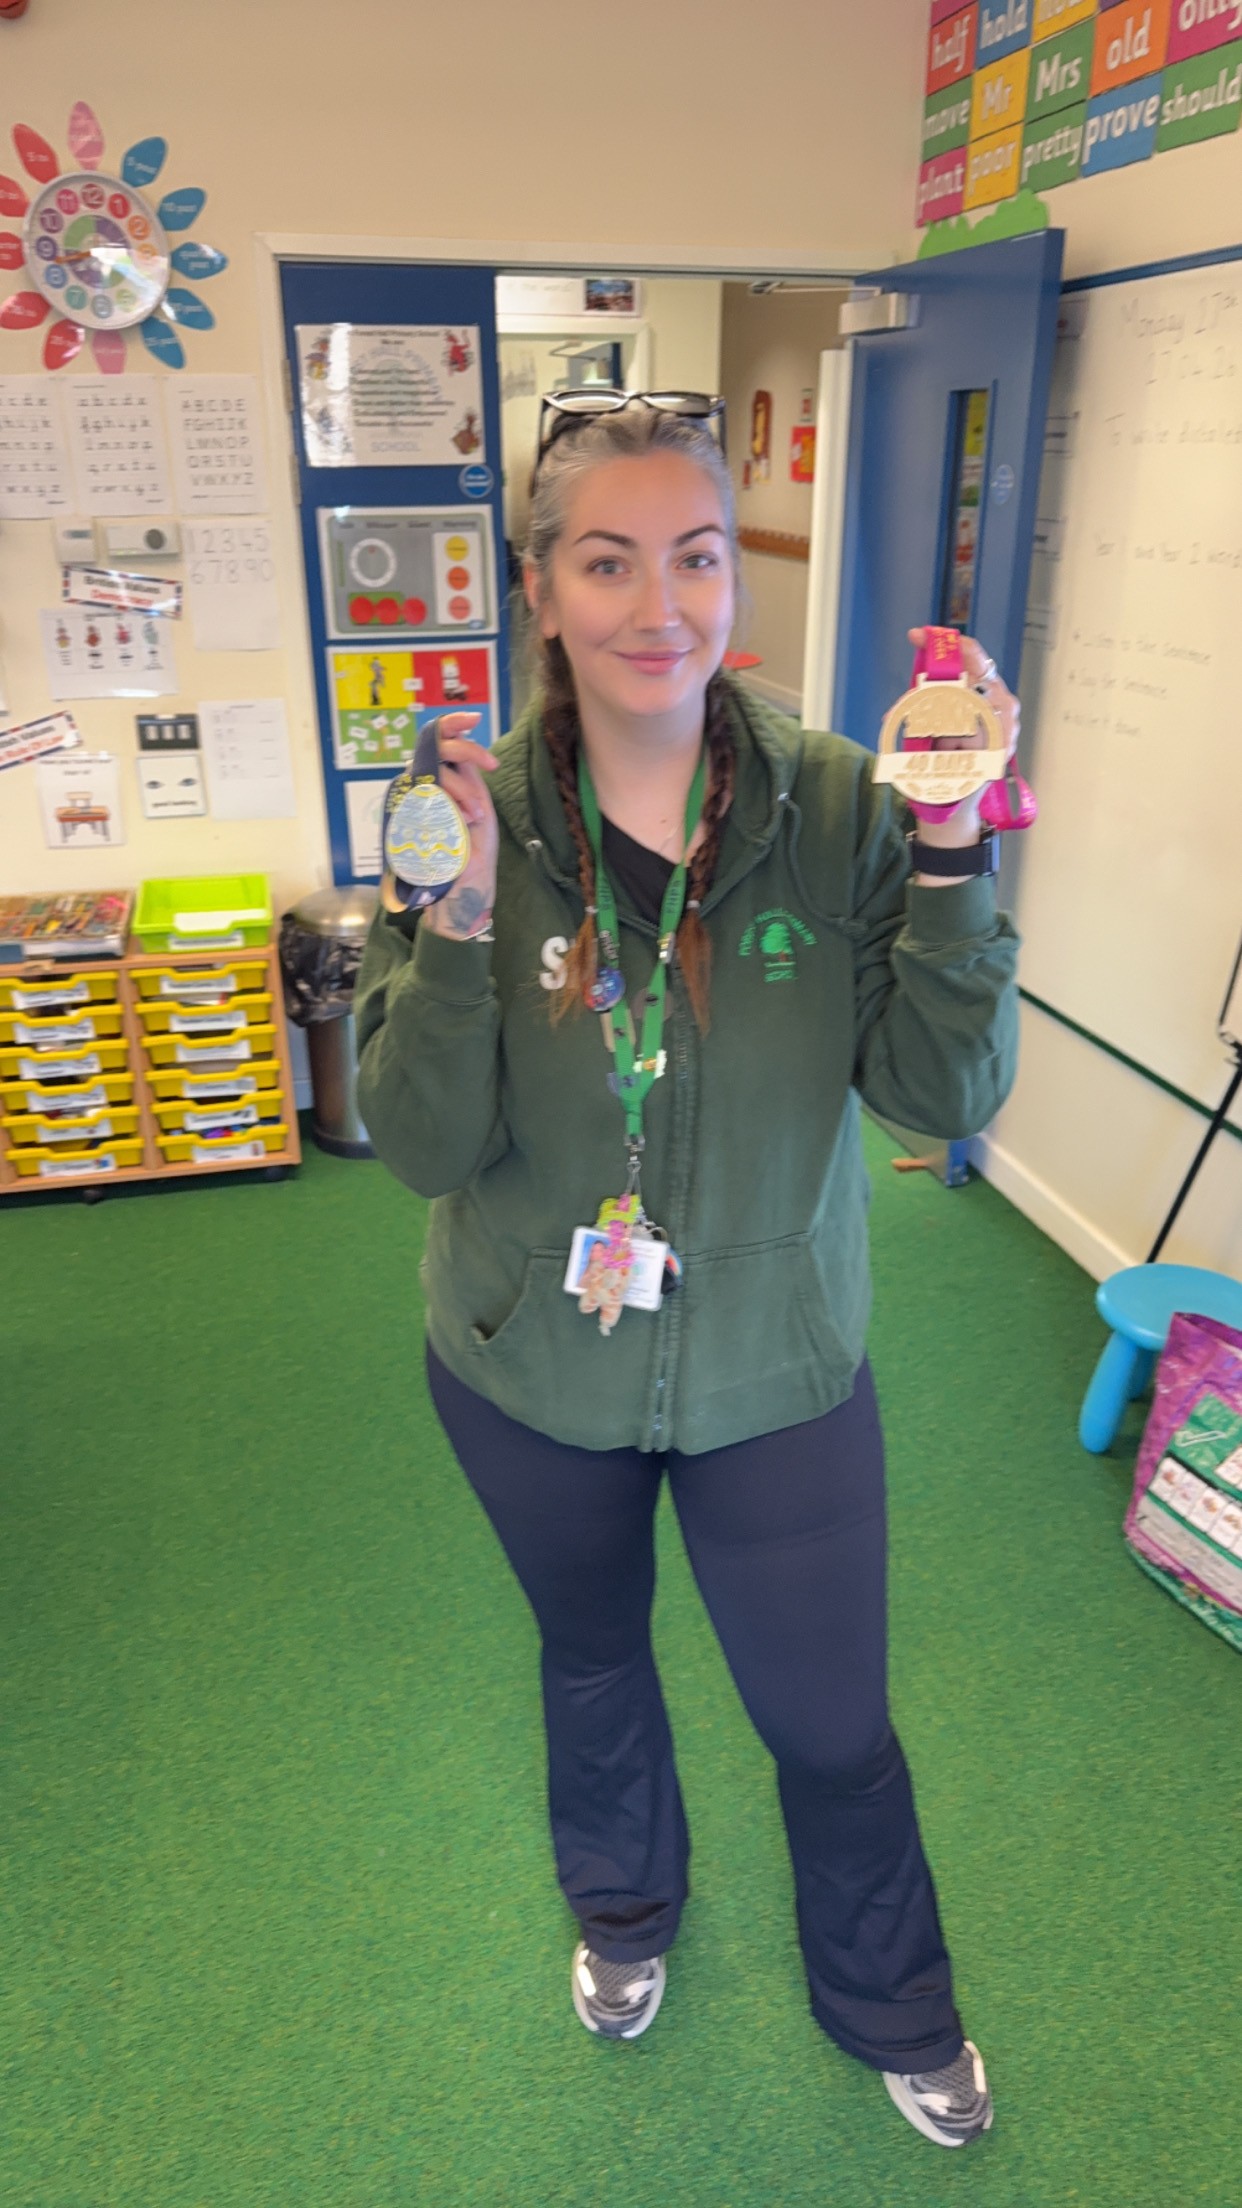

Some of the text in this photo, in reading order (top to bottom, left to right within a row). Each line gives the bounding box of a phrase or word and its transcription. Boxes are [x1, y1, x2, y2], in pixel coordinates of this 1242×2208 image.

[931, 14, 971, 73] half
[979, 0, 1028, 49] hold
[1106, 8, 1152, 71] old
[981, 75, 1012, 121] Mr
[1033, 51, 1082, 102] Mrs
[1160, 64, 1242, 126] should
[924, 97, 971, 139] move
[1081, 93, 1160, 165] prove
[968, 141, 1016, 196] poor
[1021, 124, 1083, 183] pretty
[81, 184, 104, 205] 12
[919, 163, 964, 220] plant
[41, 239, 53, 256] 9
[132, 219, 147, 236] 2
[50, 268, 63, 285] 8
[71, 290, 84, 307] 7
